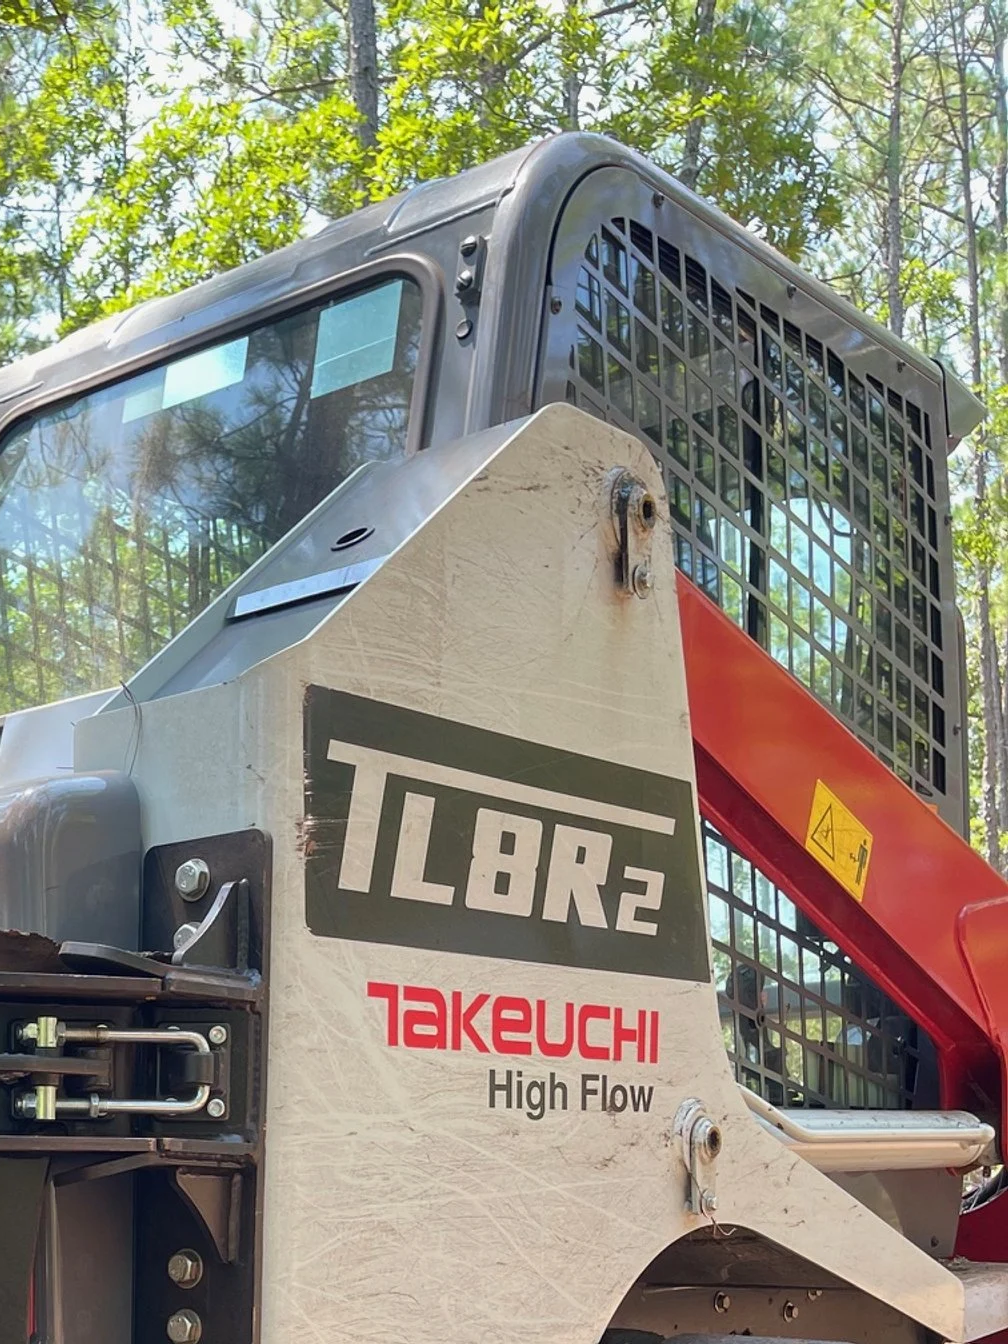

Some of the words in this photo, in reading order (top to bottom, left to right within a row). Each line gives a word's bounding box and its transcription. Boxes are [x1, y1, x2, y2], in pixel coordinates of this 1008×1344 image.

[327, 739, 676, 936] TL8R2
[489, 1070, 568, 1120] High
[581, 1074, 654, 1113] Flow
